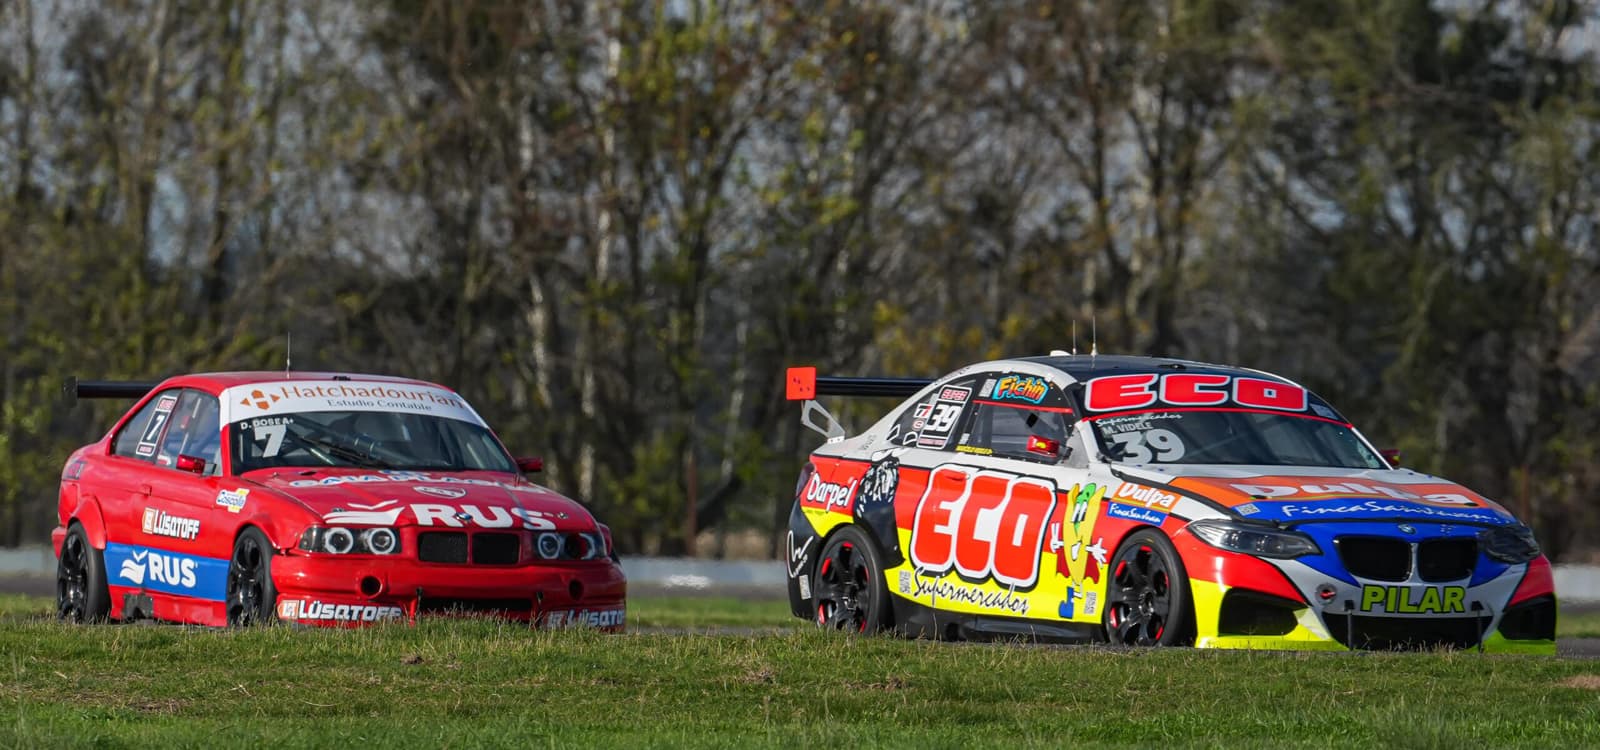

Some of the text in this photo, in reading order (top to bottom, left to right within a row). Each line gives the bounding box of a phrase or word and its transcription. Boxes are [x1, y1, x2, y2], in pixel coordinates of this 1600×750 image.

[281, 385, 466, 410] Hatchadourian
[997, 377, 1046, 400] Fichin
[1085, 374, 1308, 412] ECO
[327, 400, 432, 411] Estudio Contable
[924, 404, 962, 432] 39
[147, 414, 165, 440] 7
[254, 424, 287, 458] 7
[1112, 429, 1185, 464] 39
[806, 472, 858, 511] Darpel
[1118, 483, 1177, 508] Dulpa
[1229, 482, 1468, 505] Dulpa
[409, 503, 557, 531] RUS
[911, 464, 1057, 590] ECO
[149, 552, 197, 588] RUS
[913, 566, 1030, 616] Supermercados
[1361, 584, 1466, 613] PILAR
